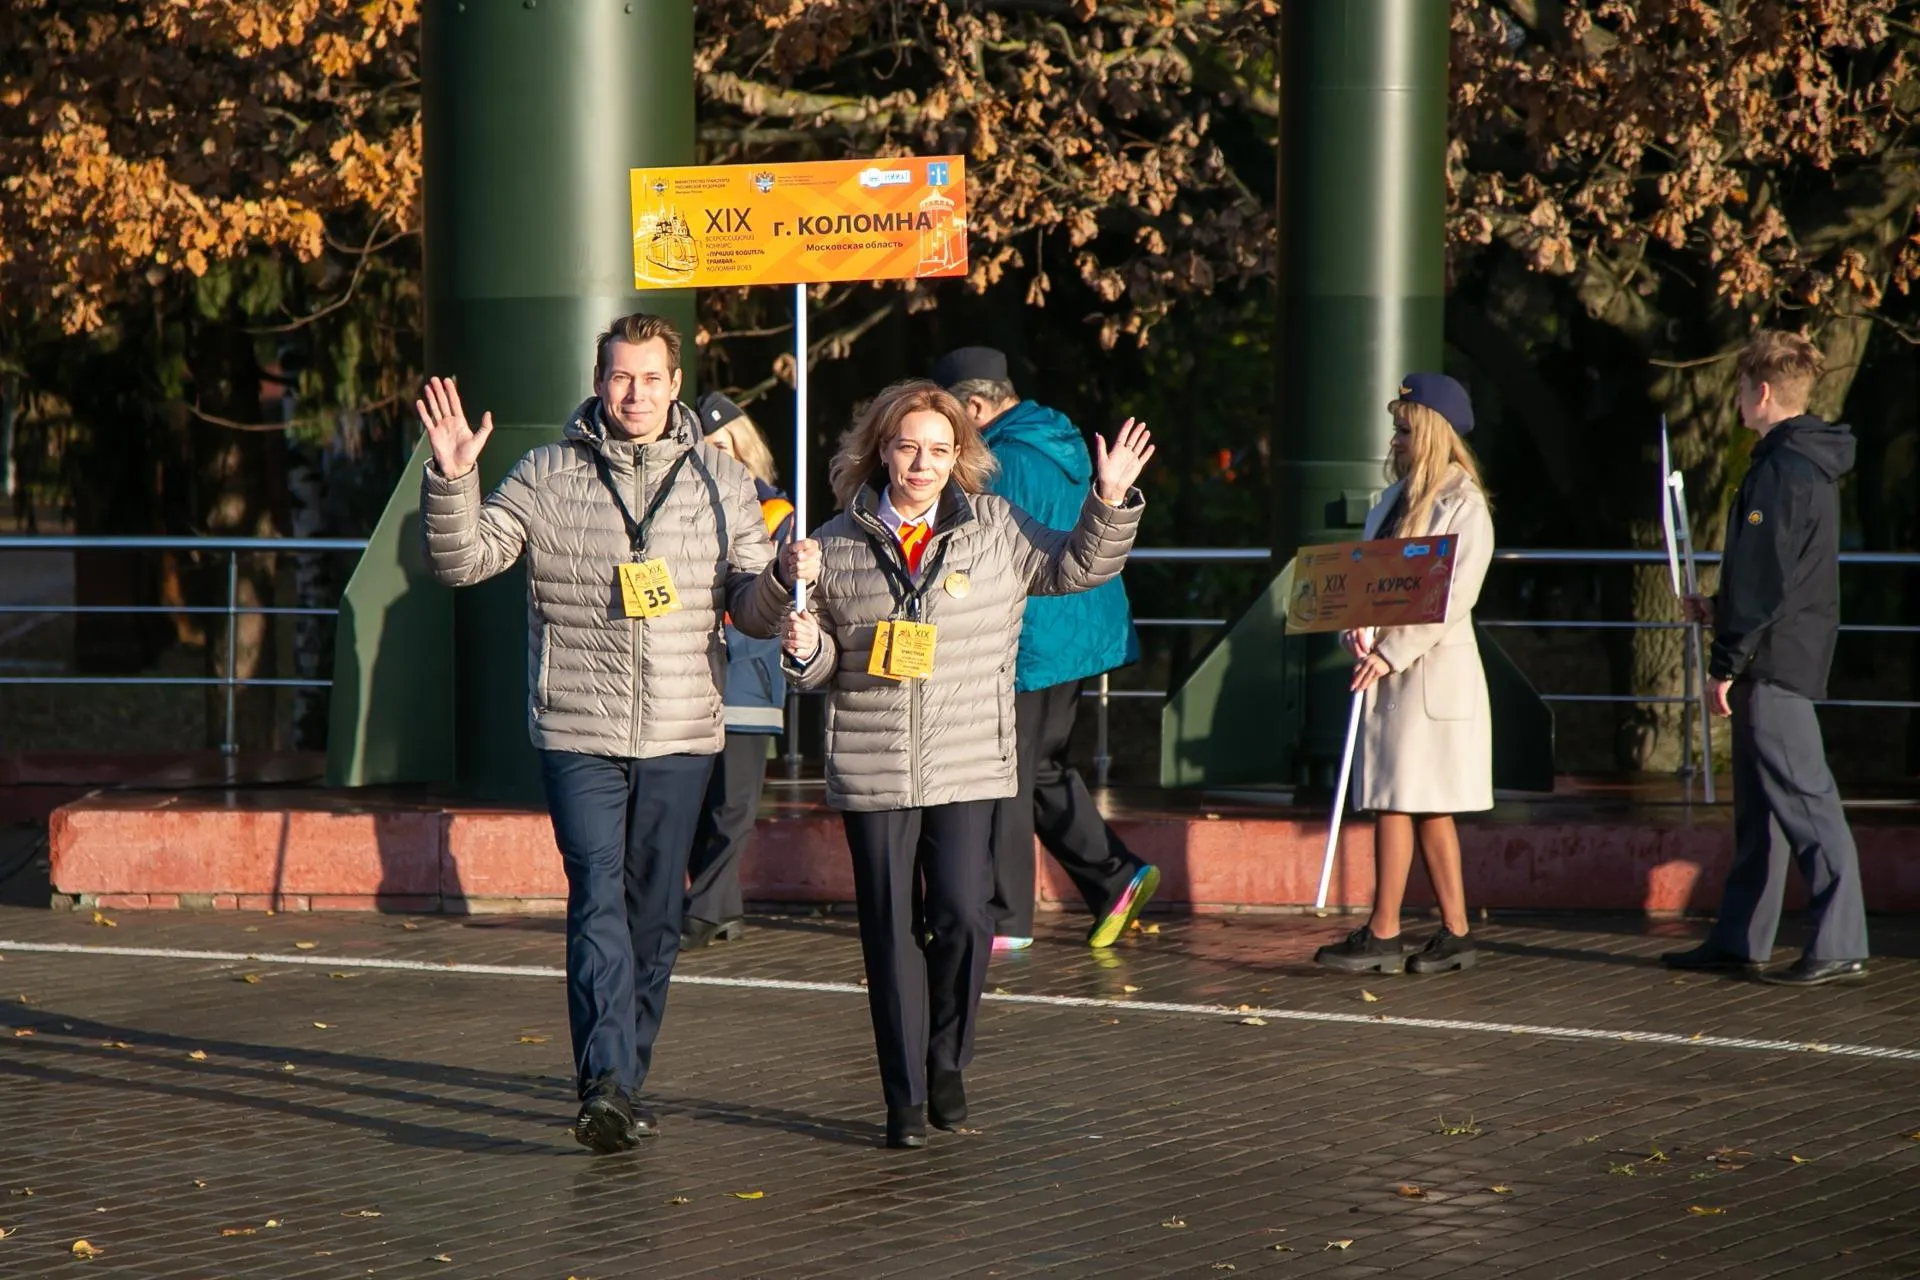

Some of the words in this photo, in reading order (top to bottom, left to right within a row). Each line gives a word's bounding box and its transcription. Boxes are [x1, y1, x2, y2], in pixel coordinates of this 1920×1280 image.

[705, 207, 752, 233] XIX
[774, 221, 791, 236] г.
[798, 211, 933, 236] КОЛОМНА
[806, 241, 864, 252] Московская
[865, 240, 904, 250] область
[1323, 574, 1348, 594] XIX
[1365, 582, 1375, 594] г.
[1377, 575, 1423, 594] КУРСК
[644, 585, 671, 609] 35
[914, 628, 930, 640] XIX
